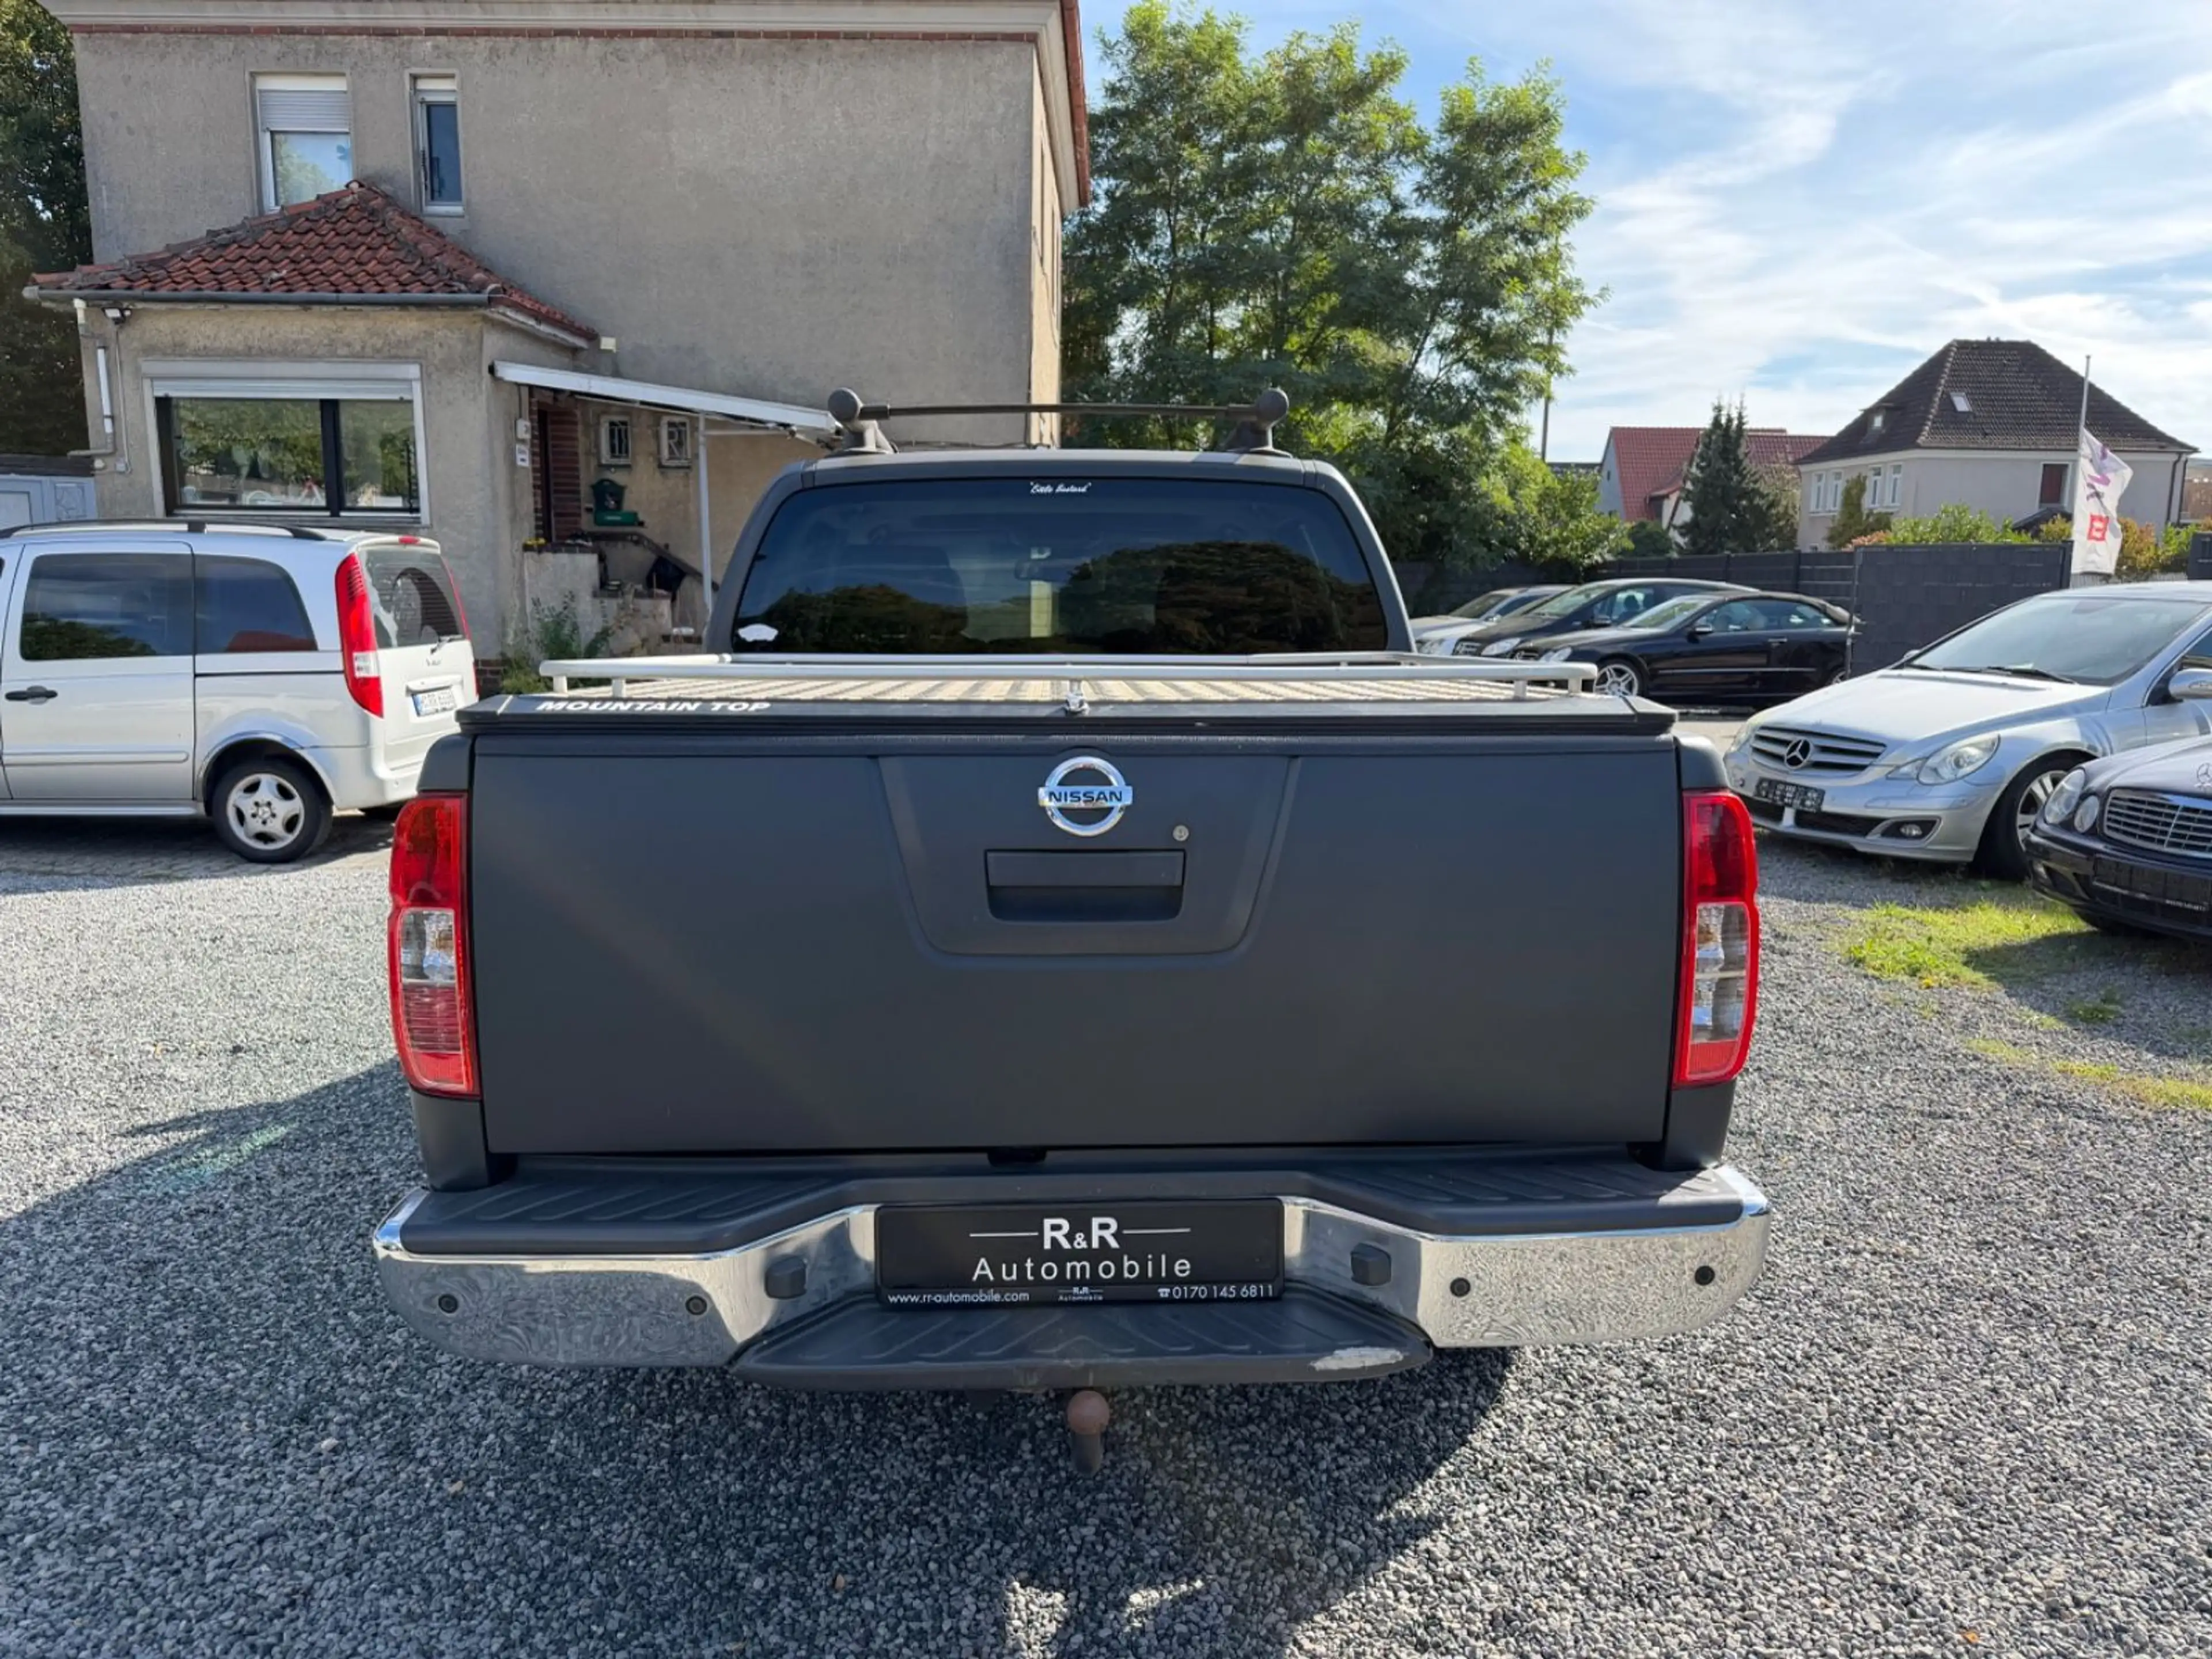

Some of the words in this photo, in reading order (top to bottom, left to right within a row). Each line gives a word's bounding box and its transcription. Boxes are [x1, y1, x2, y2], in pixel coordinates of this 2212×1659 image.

[535, 700, 701, 712] MOUNTAIN
[710, 700, 771, 712] TOP
[1048, 790, 1122, 803] NISSAN
[1043, 1216, 1120, 1250] R&R
[972, 1253, 1191, 1282] Automobile
[888, 1289, 1030, 1304] www.rr-automobile.com
[1172, 1286, 1208, 1299] 0170
[1213, 1285, 1237, 1298] 145
[1240, 1283, 1273, 1298] 6811
